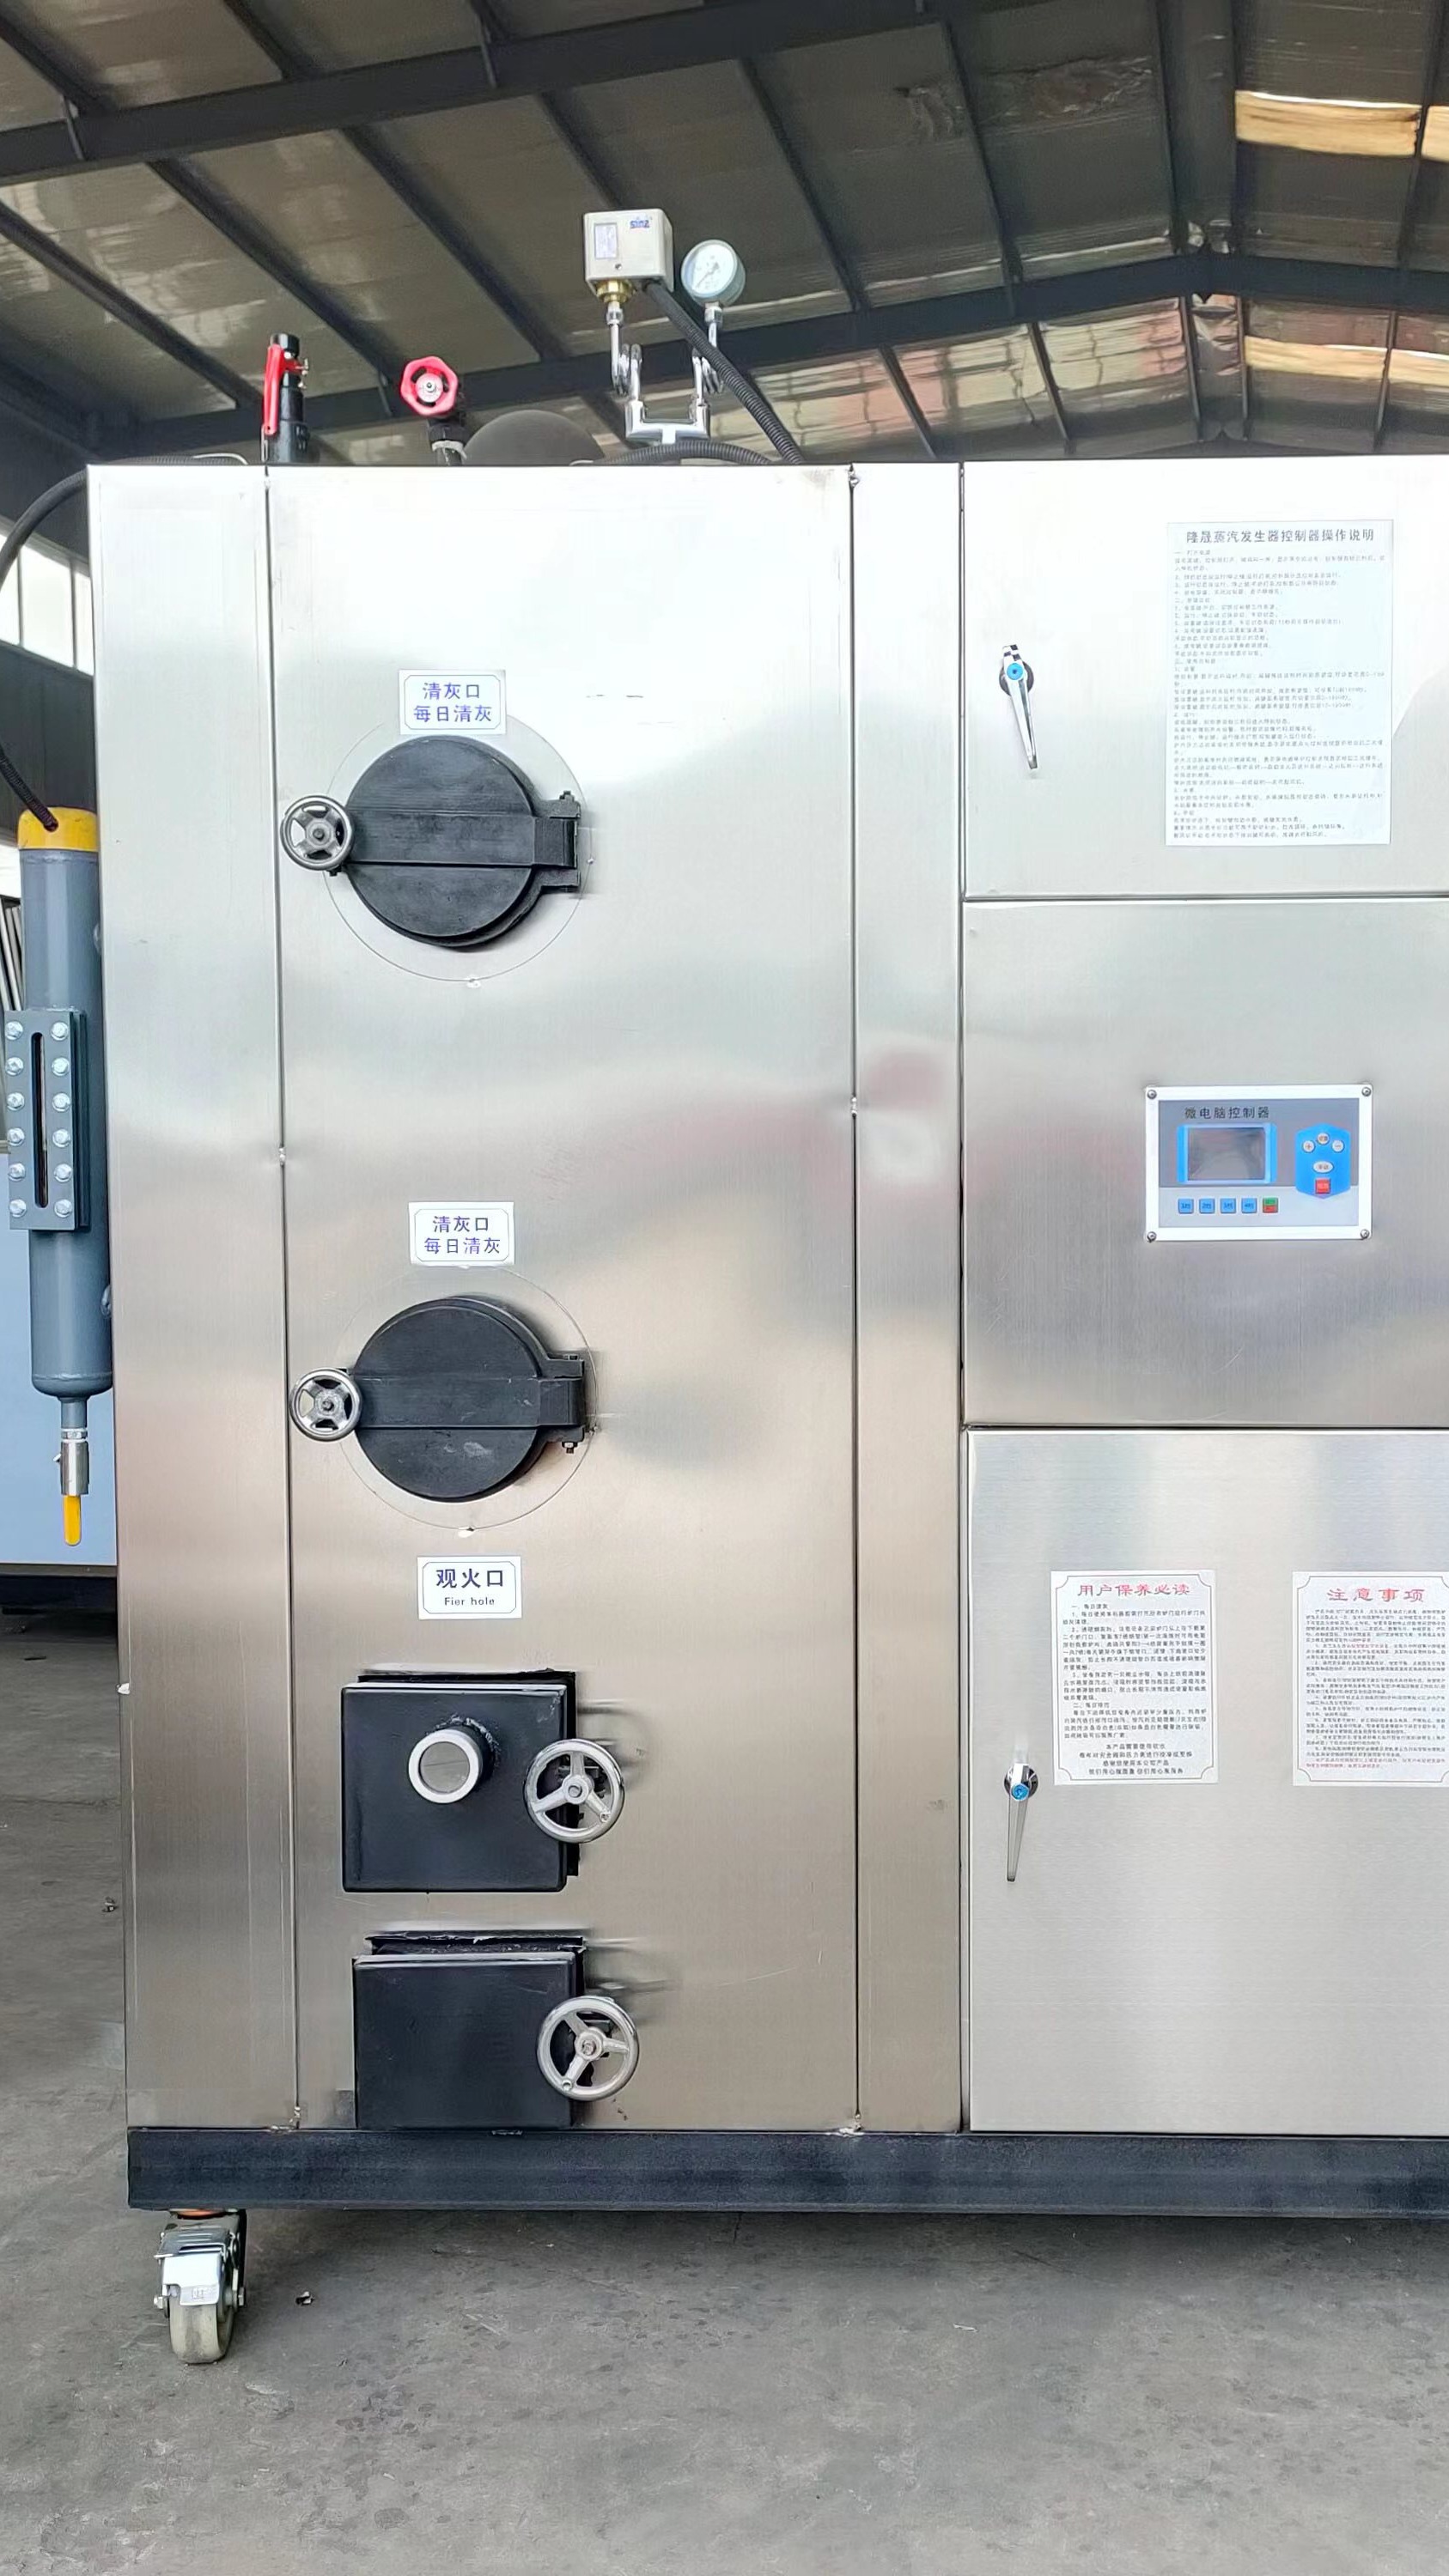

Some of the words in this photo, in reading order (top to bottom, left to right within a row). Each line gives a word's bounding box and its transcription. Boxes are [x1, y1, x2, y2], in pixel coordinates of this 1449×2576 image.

[1186, 528, 1375, 544] 隆晟蒸汽发生器控制器操作说明
[422, 682, 480, 700] 清灰口
[413, 704, 492, 723] 每日清灰
[1184, 1106, 1269, 1120] 微电脑控制器
[432, 1215, 489, 1233] 清灰口
[424, 1236, 501, 1255] 每日清灰
[435, 1568, 503, 1589] 观火口
[1077, 1583, 1190, 1597] 用户保养必读
[1326, 1588, 1425, 1602] 注意事项
[444, 1596, 466, 1606] Fier
[471, 1596, 496, 1606] hole
